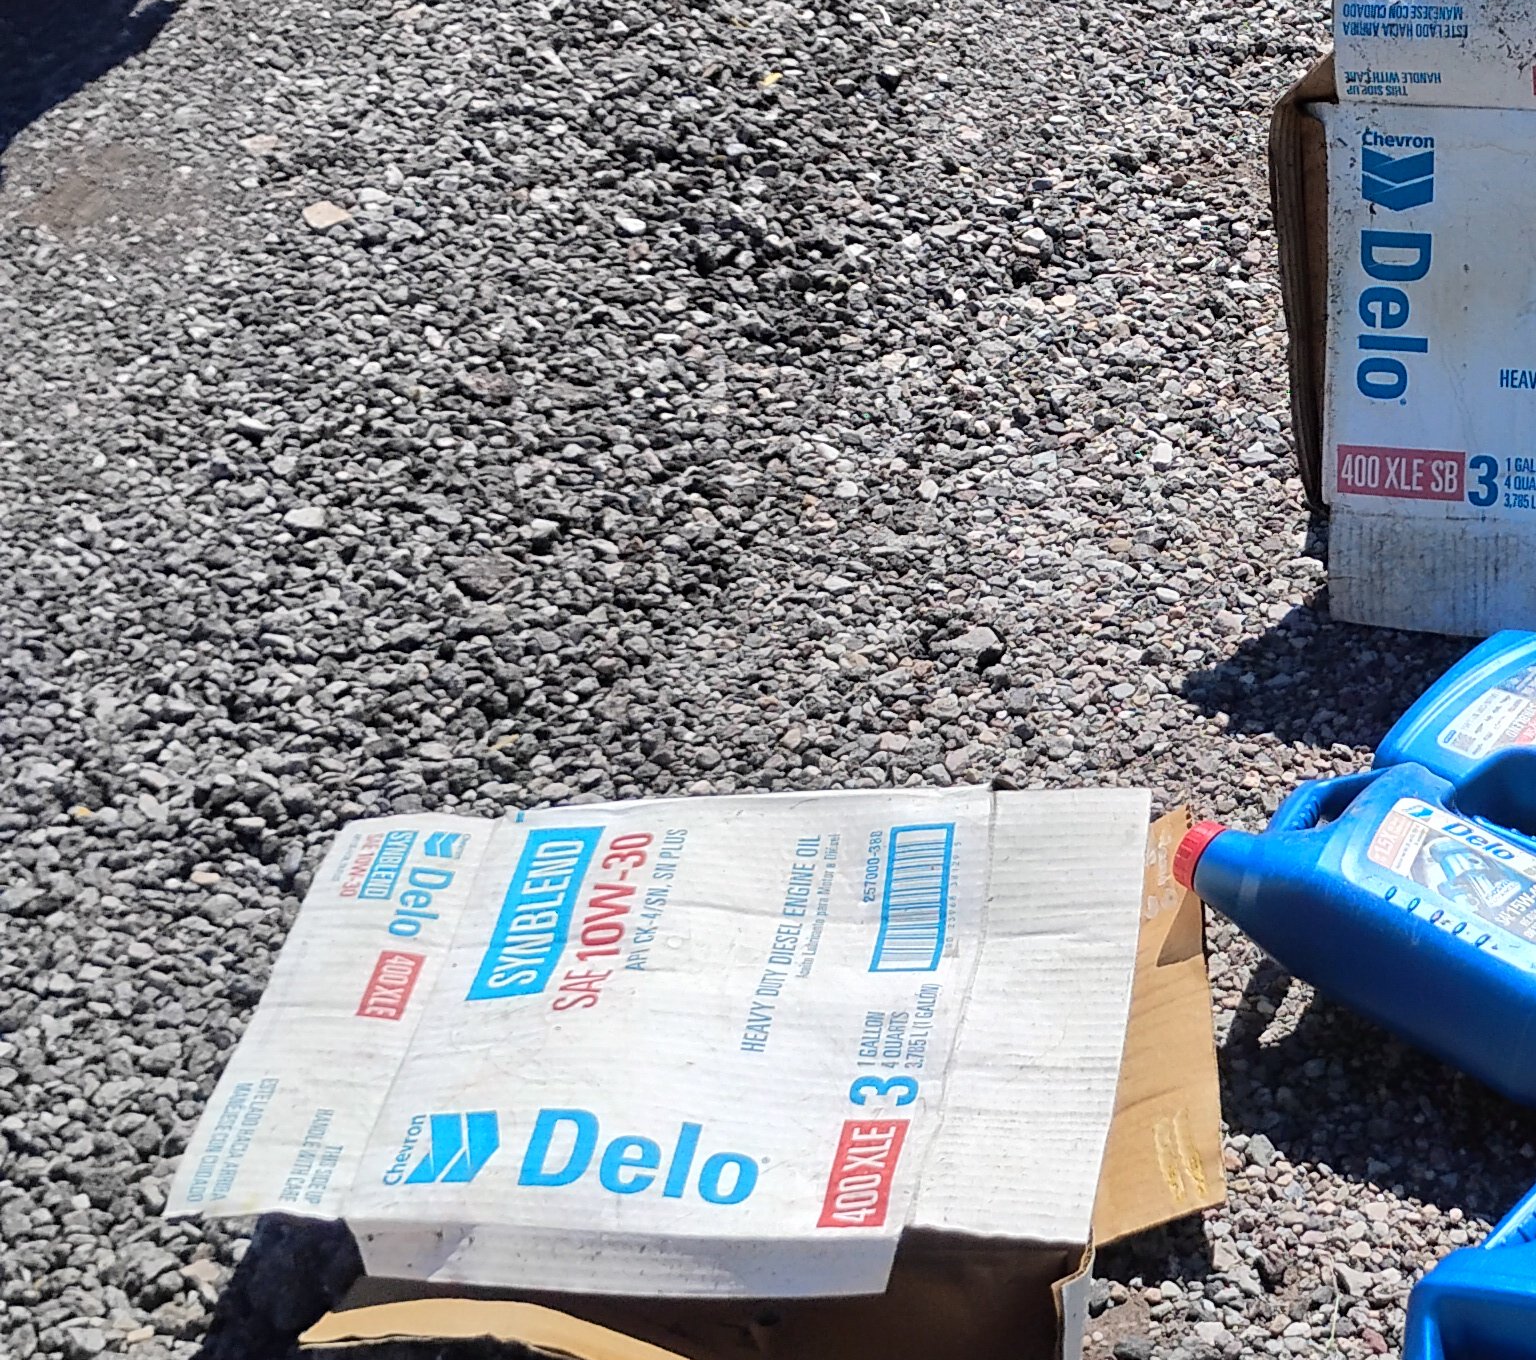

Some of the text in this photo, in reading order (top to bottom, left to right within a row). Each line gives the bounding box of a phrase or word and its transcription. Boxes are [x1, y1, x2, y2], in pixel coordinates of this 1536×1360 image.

[1342, 3, 1387, 18] CUIDADO
[1342, 21, 1380, 37] ARRIBA
[1388, 4, 1409, 19] CON
[1416, 24, 1442, 39] LADO
[1446, 24, 1468, 39] ESTE
[1347, 84, 1361, 96] UP
[1373, 71, 1400, 83] WITH
[1385, 85, 1408, 97] THIS
[1403, 71, 1441, 84] HANDLE
[1362, 129, 1435, 149] Chevron
[1356, 229, 1432, 400] Delo
[1341, 454, 1459, 493] 400 XLE SB
[1467, 455, 1499, 507] 3
[1504, 475, 1512, 490] 4
[1505, 458, 1512, 472] 1
[1531, 495, 1536, 509] L
[1442, 822, 1515, 860] Delo
[339, 852, 374, 898] 10W-30
[365, 830, 413, 898] SYNBLEND
[388, 866, 456, 938] Delo
[488, 839, 585, 989] SYNBLEND
[625, 828, 689, 971] API CK-4/SN, SN PLUS
[552, 832, 654, 1012] SAE 10W-30
[741, 834, 822, 1052] HEAVY DUTY DIESEL ENGINE OIL
[365, 955, 416, 1017] 400 XLE
[915, 982, 943, 1020] GALÓN)
[859, 1010, 886, 1059] GALLON
[881, 1010, 910, 1070] 4 QUARTS
[254, 1078, 279, 1101] ESTE
[850, 1075, 919, 1107] 3
[241, 1101, 268, 1127] LADO
[205, 1133, 230, 1153] CON
[228, 1128, 255, 1159] HACIA
[279, 1109, 335, 1203] HANDLE WITH CARE
[384, 1114, 427, 1187] Chevron
[517, 1108, 760, 1206] Delo
[186, 1154, 219, 1202] CUIDADO
[304, 1145, 344, 1205] THIS SIDE UP
[832, 1125, 897, 1224] 400 XLE
